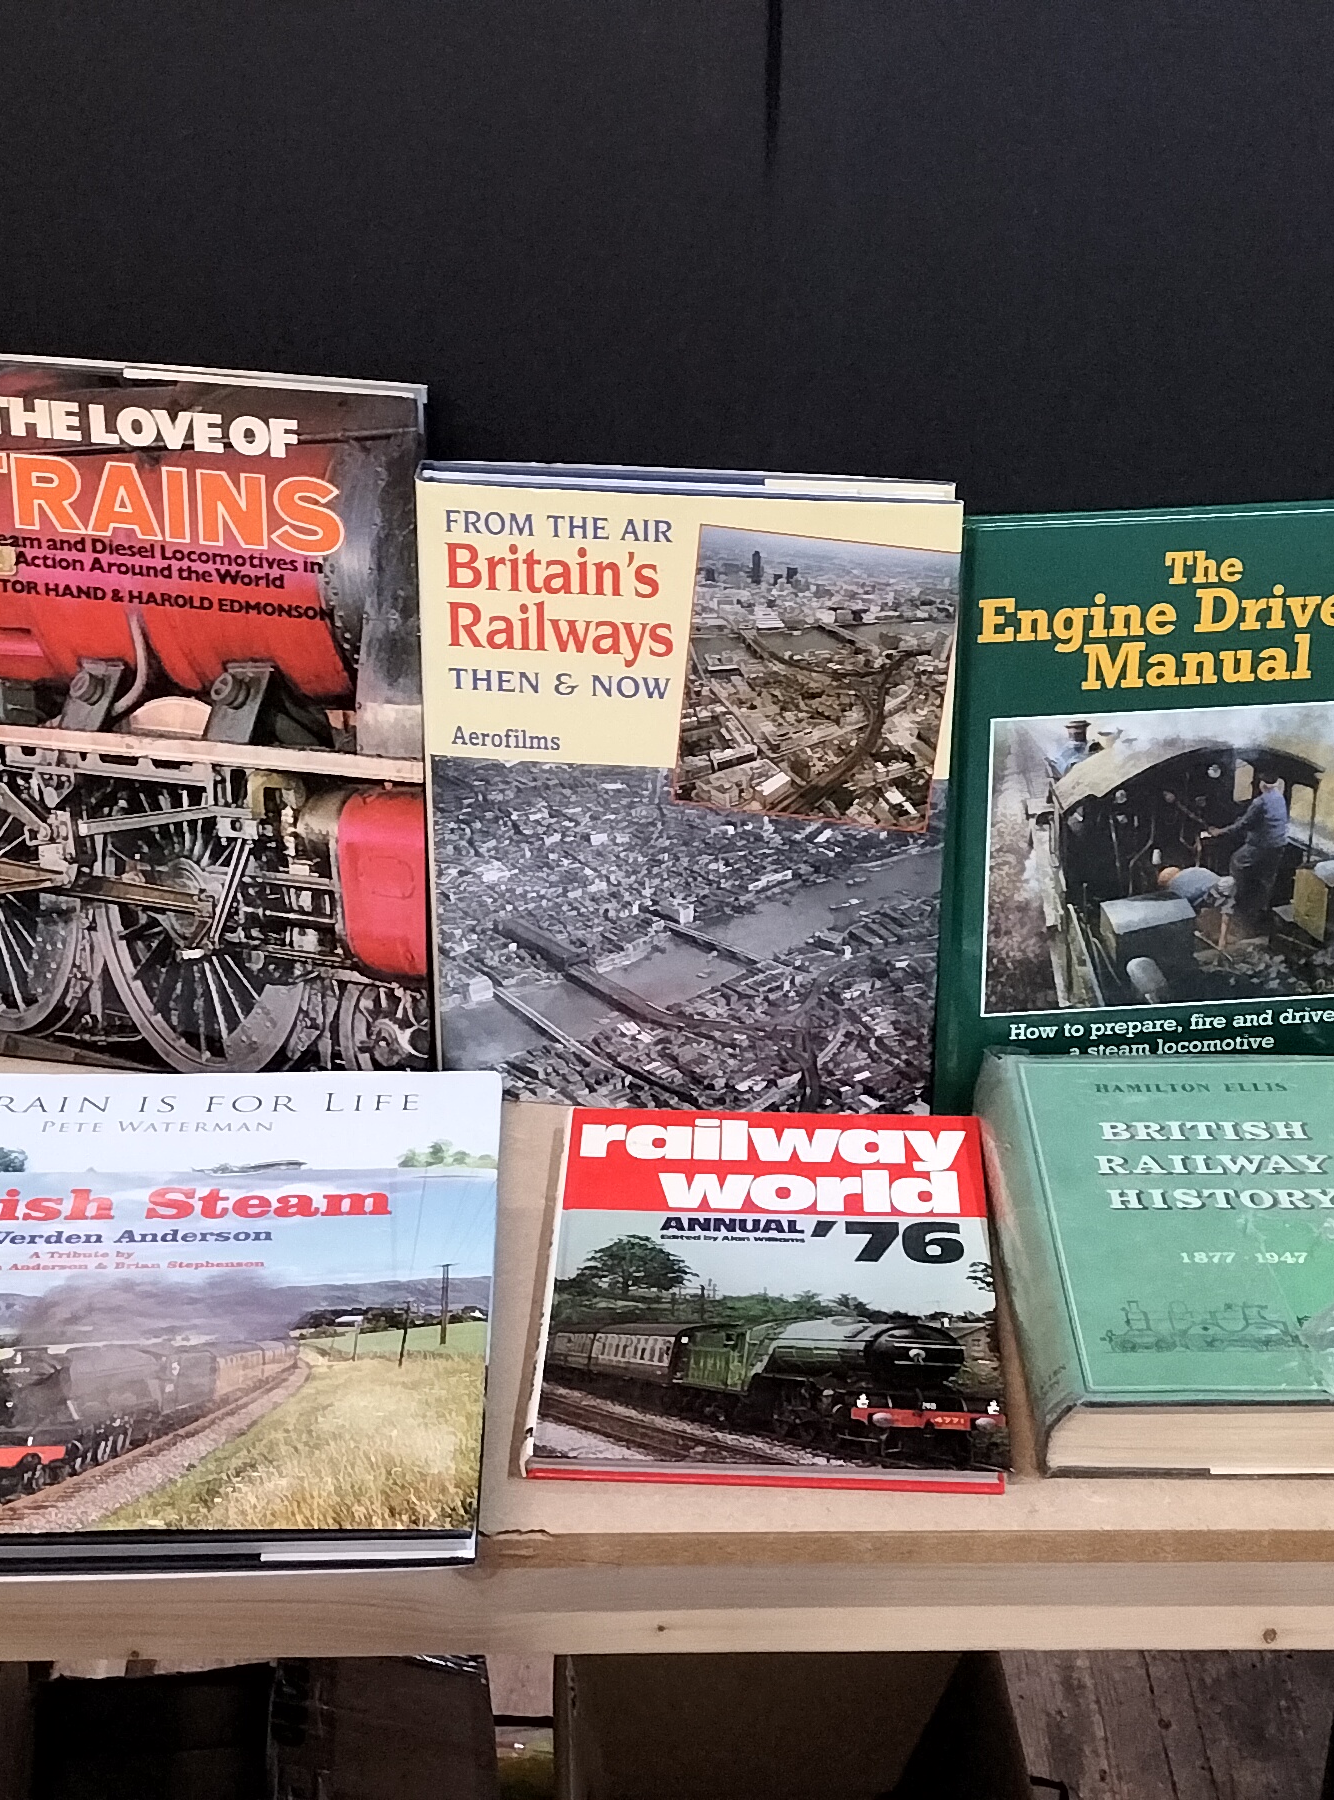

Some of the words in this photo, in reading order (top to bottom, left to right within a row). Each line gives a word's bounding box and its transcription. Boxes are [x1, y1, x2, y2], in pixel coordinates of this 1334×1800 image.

[90, 403, 224, 454] LOVE
[229, 417, 299, 459] OF
[445, 509, 535, 537] FROM
[547, 514, 610, 539] THE
[620, 518, 673, 543] AIR
[14, 551, 85, 572] Action
[90, 556, 173, 579] Around
[177, 565, 213, 583] the
[216, 567, 285, 589] World
[47, 537, 86, 553] and
[91, 538, 152, 560] Diesel
[160, 545, 298, 573] Locomotives
[445, 542, 660, 599] Britain's
[1165, 550, 1243, 585] The
[45, 582, 106, 601] HAND
[128, 590, 214, 611] HAROLD
[218, 598, 335, 623] EDMONSON
[447, 600, 674, 667] Railways
[977, 593, 1177, 653] Engine
[1081, 633, 1312, 690] Manual
[449, 668, 540, 694] THEN
[554, 673, 579, 697] &
[591, 676, 671, 700] NOW
[451, 727, 561, 751] Aerofilms
[1009, 1024, 1058, 1040] How
[1064, 1023, 1084, 1037] to
[1089, 1018, 1183, 1040] prepare,
[1190, 1013, 1228, 1030] fire
[1233, 1010, 1273, 1027] and
[1087, 1041, 1150, 1056] steam
[1156, 1035, 1275, 1055] locomotive
[139, 1095, 176, 1113] IS
[206, 1094, 298, 1113] FOR
[325, 1092, 420, 1112] LIFE
[1095, 1082, 1211, 1094] HAMILTON
[1225, 1081, 1288, 1093] ELLIS
[41, 1120, 104, 1133] PETE
[118, 1121, 274, 1132] WATERMAN
[1098, 1120, 1314, 1142] BRITISH
[579, 1118, 966, 1172] railway
[1094, 1154, 1331, 1176] RAILWAY
[145, 1187, 392, 1220] Steam
[658, 1170, 961, 1214] world
[113, 1229, 273, 1244] Anderson
[660, 1217, 805, 1235] ANNUAL
[811, 1220, 965, 1264] '76
[9, 1262, 88, 1271] Anderson
[114, 1262, 160, 1270] Brian
[167, 1261, 265, 1270] Stephenson
[1180, 1252, 1236, 1263] 1877
[1254, 1252, 1308, 1264] 1947
